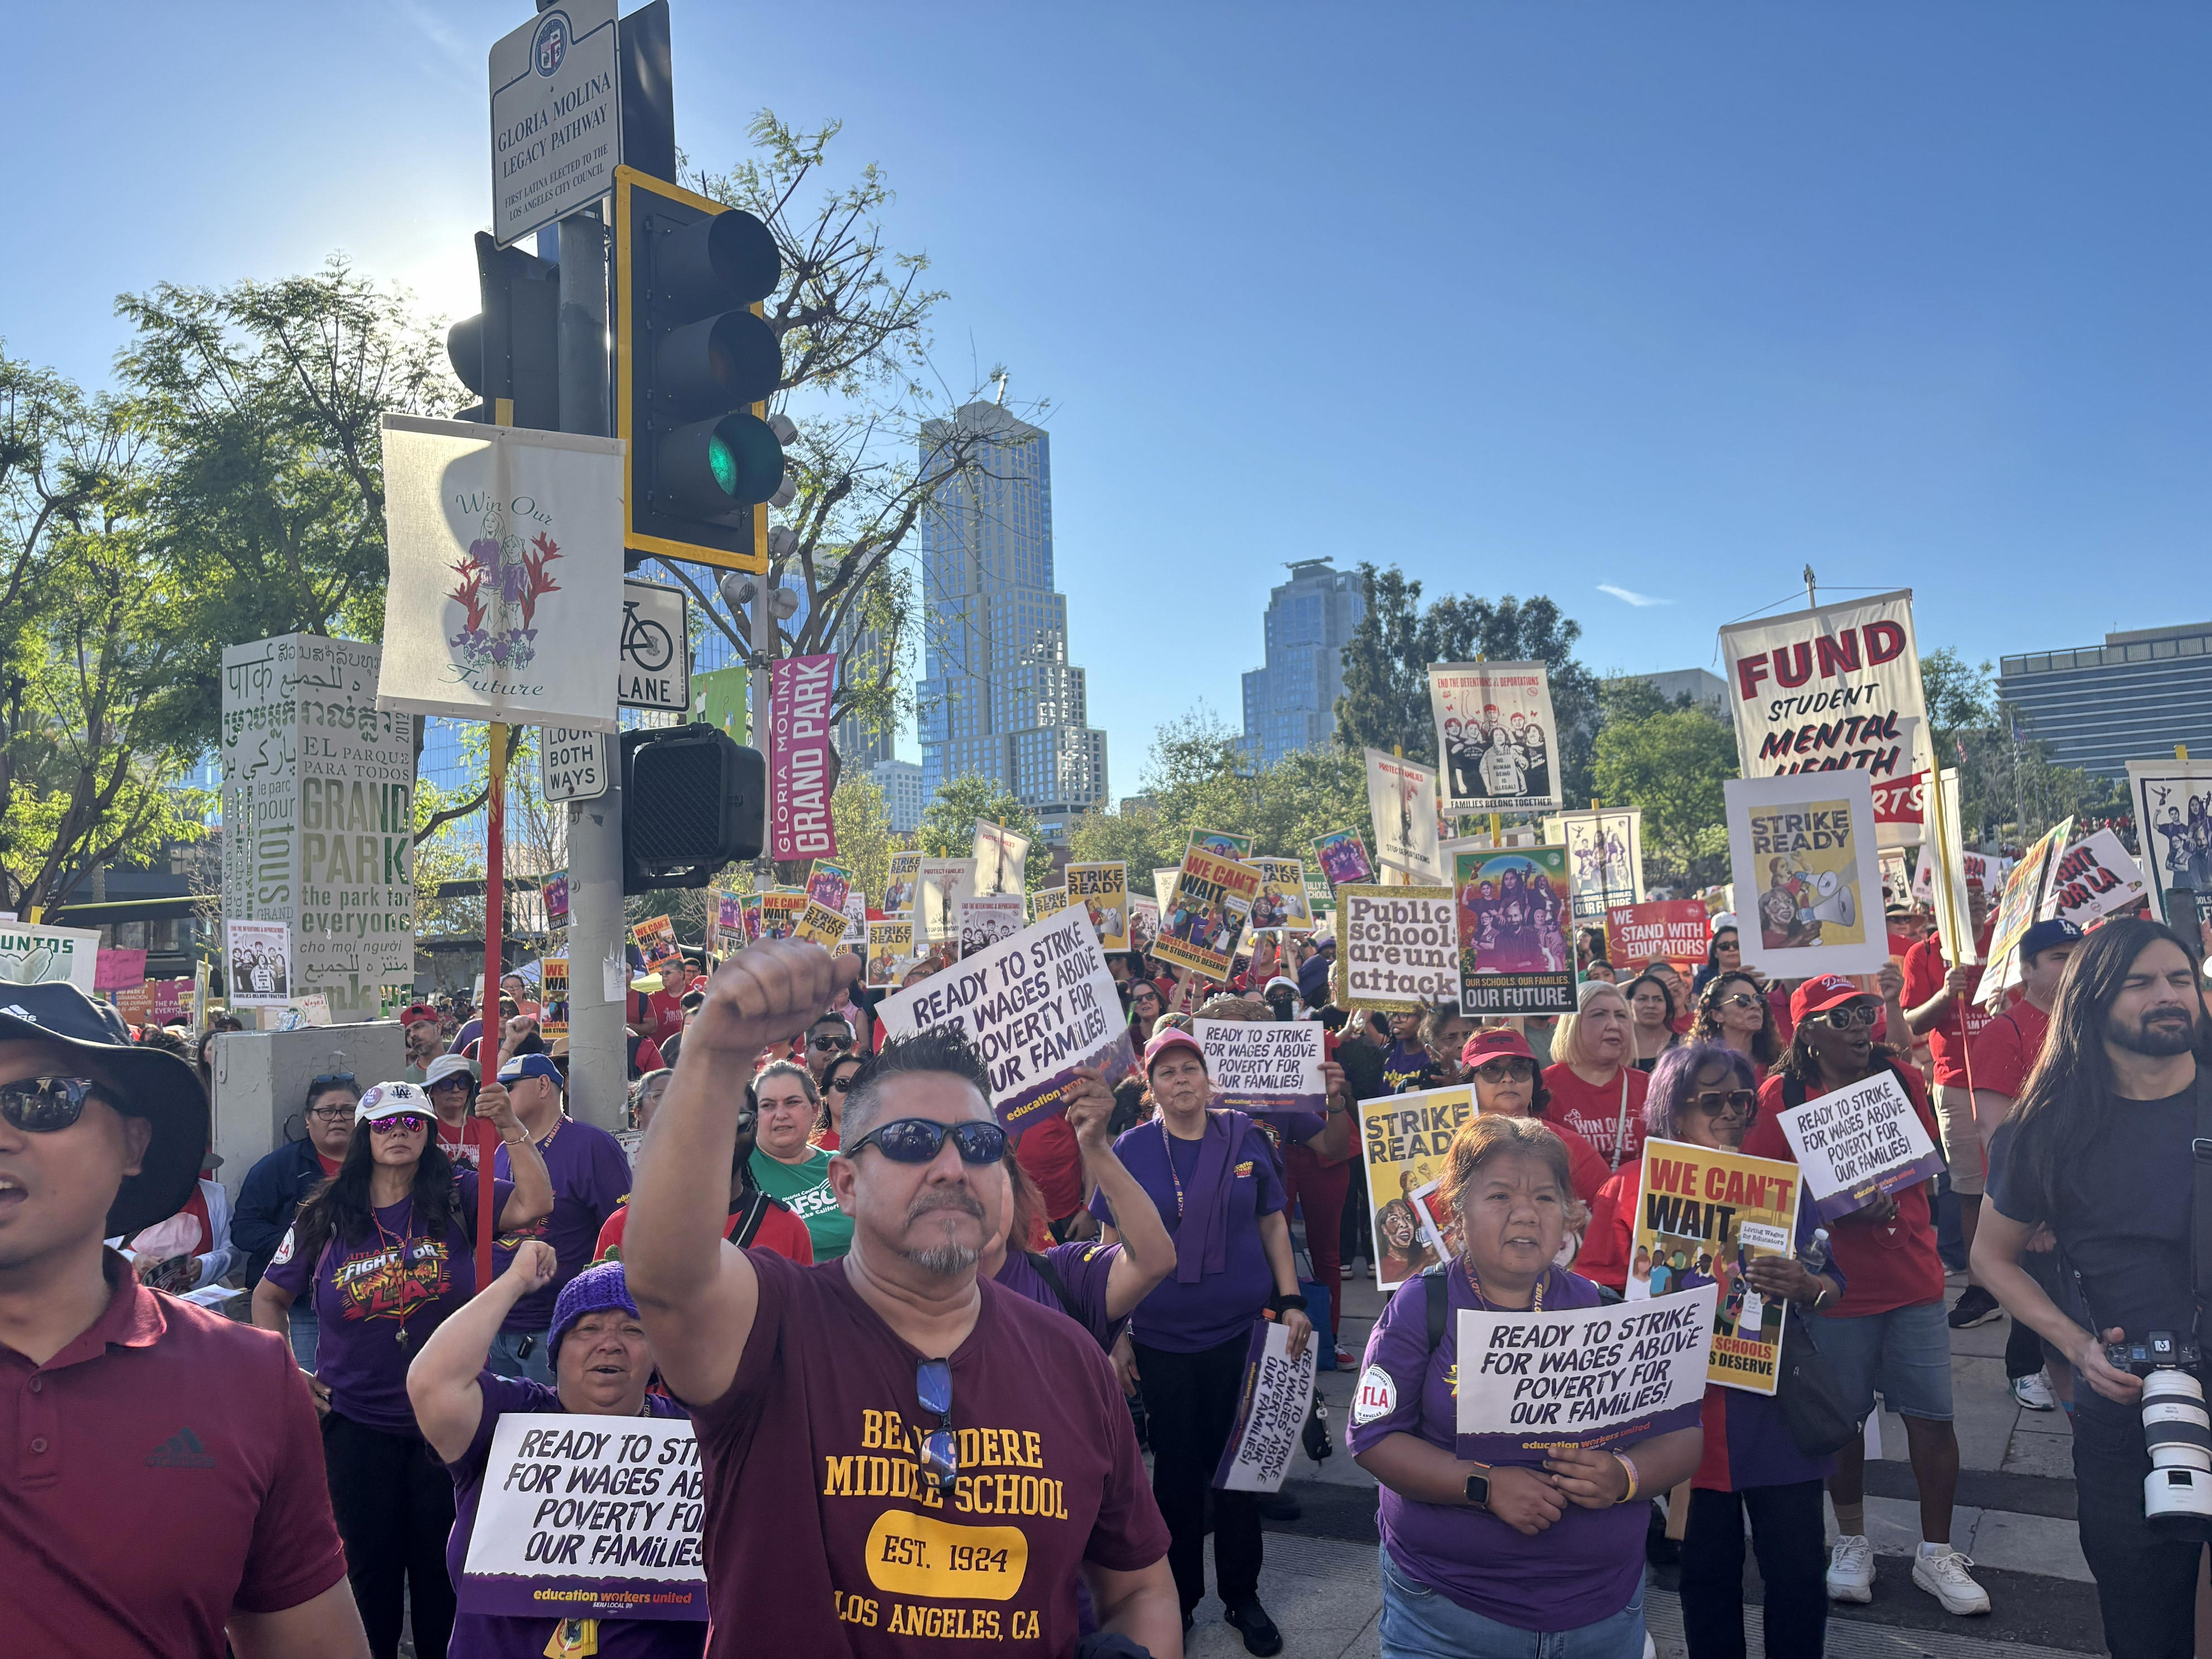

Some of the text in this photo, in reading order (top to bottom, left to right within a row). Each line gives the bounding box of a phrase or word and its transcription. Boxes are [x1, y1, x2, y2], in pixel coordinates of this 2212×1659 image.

[498, 71, 611, 152] GLORIA MOLINA
[503, 104, 608, 179] LEGACY PATHWAY
[505, 143, 608, 209] FIRST LATINA ELECTED TO THE
[509, 162, 605, 221] LOS ANGELES CITY COUNCIL
[456, 491, 553, 525] Win Our
[1737, 620, 1907, 701] FUND
[438, 664, 544, 696] Future
[618, 673, 671, 703] LANE
[1438, 678, 1449, 688] END
[1450, 677, 1460, 688] THE
[1461, 677, 1492, 688] DETENTIONS
[1500, 676, 1539, 687] DEPORTATIONS
[1768, 683, 1880, 722] STUDENT
[396, 713, 409, 744] 2012
[1759, 710, 1903, 760] MENTAL
[303, 736, 409, 765] EL PARQUE
[550, 744, 593, 767] BOTH
[777, 663, 792, 852] GLORIA MOLINA
[792, 658, 830, 853] GRAND PARK
[303, 761, 409, 781] PARA TODOS
[551, 768, 595, 790] WAYS
[258, 797, 296, 827] pour
[303, 777, 409, 834] GRAND
[1451, 798, 1553, 809] FAMILIES BELONG TOGETHER
[1751, 810, 1850, 836] STRIKE
[1754, 828, 1849, 855] READY
[258, 823, 295, 904] tous
[303, 833, 409, 885] PARK
[890, 864, 919, 874] READY
[892, 856, 921, 866] STRIKE
[1068, 869, 1124, 883] STRIKE
[1068, 881, 1124, 895] READY
[1179, 873, 1227, 904] WAIT
[1185, 855, 1259, 894] WE CAN'T
[302, 885, 411, 910] the park for
[764, 897, 807, 909] WE CAN'T
[1351, 899, 1451, 924] Public
[302, 912, 411, 939] everyone
[764, 908, 791, 920] WAIT
[803, 914, 844, 938] READY
[808, 906, 847, 930] STRIKE
[1612, 909, 1634, 925] WE
[870, 925, 912, 935] STRIKE
[870, 934, 911, 944] READY
[1350, 922, 1456, 948] school
[1621, 922, 1703, 942] STAND WITH
[300, 941, 325, 953] cho
[1156, 941, 1170, 952] OUR
[1170, 946, 1201, 963] STUDENTS
[1627, 939, 1705, 958] EDUCATORS
[913, 920, 1086, 1028] READY TO STRIKE
[1350, 971, 1457, 996] attack
[1466, 975, 1570, 987] OUR SCHOOLS. OUR FAMILIES.
[972, 945, 1099, 1033] WAGES ABOVE
[1466, 987, 1572, 1009] OUR FUTURE.
[1206, 1027, 1313, 1043] READY TO STRIKE
[1203, 1043, 1318, 1057] FOR WAGES ABOVE
[989, 1056, 1025, 1093] UR
[1218, 1059, 1300, 1073] POVERTY FOR
[1218, 1073, 1241, 1088] OUR
[1006, 1089, 1061, 1122] education
[1797, 1082, 1893, 1133] READY TO STRIKE
[1366, 1102, 1471, 1140] STRIKE
[1803, 1097, 1906, 1152] FOR WAGES ABOVE
[1828, 1121, 1902, 1165] POVERTY FOR
[1650, 1158, 1793, 1212] WE CAN'T
[1835, 1160, 1859, 1183] OUR
[1647, 1193, 1736, 1242] WAIT
[1744, 1226, 1785, 1238] Living Wages
[344, 1243, 440, 1282] FIGHT OR
[350, 1249, 382, 1260] UTLA
[1489, 1303, 1701, 1349] READY TO STRIKE
[1480, 1325, 1704, 1375] FOR WAGES ABOVE
[1715, 1338, 1771, 1360] SCHOOLS
[1718, 1353, 1774, 1376] DESERVE
[1514, 1358, 1672, 1401] POVERTY FOR
[1509, 1400, 1562, 1426] OUR
[518, 1429, 652, 1463] READY TO
[503, 1463, 664, 1495] FOR WAGES
[824, 1456, 1068, 1520] MIDDLE SCHOOL
[524, 1532, 585, 1565] OUR
[881, 1535, 1009, 1573] EST. 1924
[533, 1588, 692, 1604] education workers united
[834, 1591, 1040, 1642] LOS ANGELES, CA
